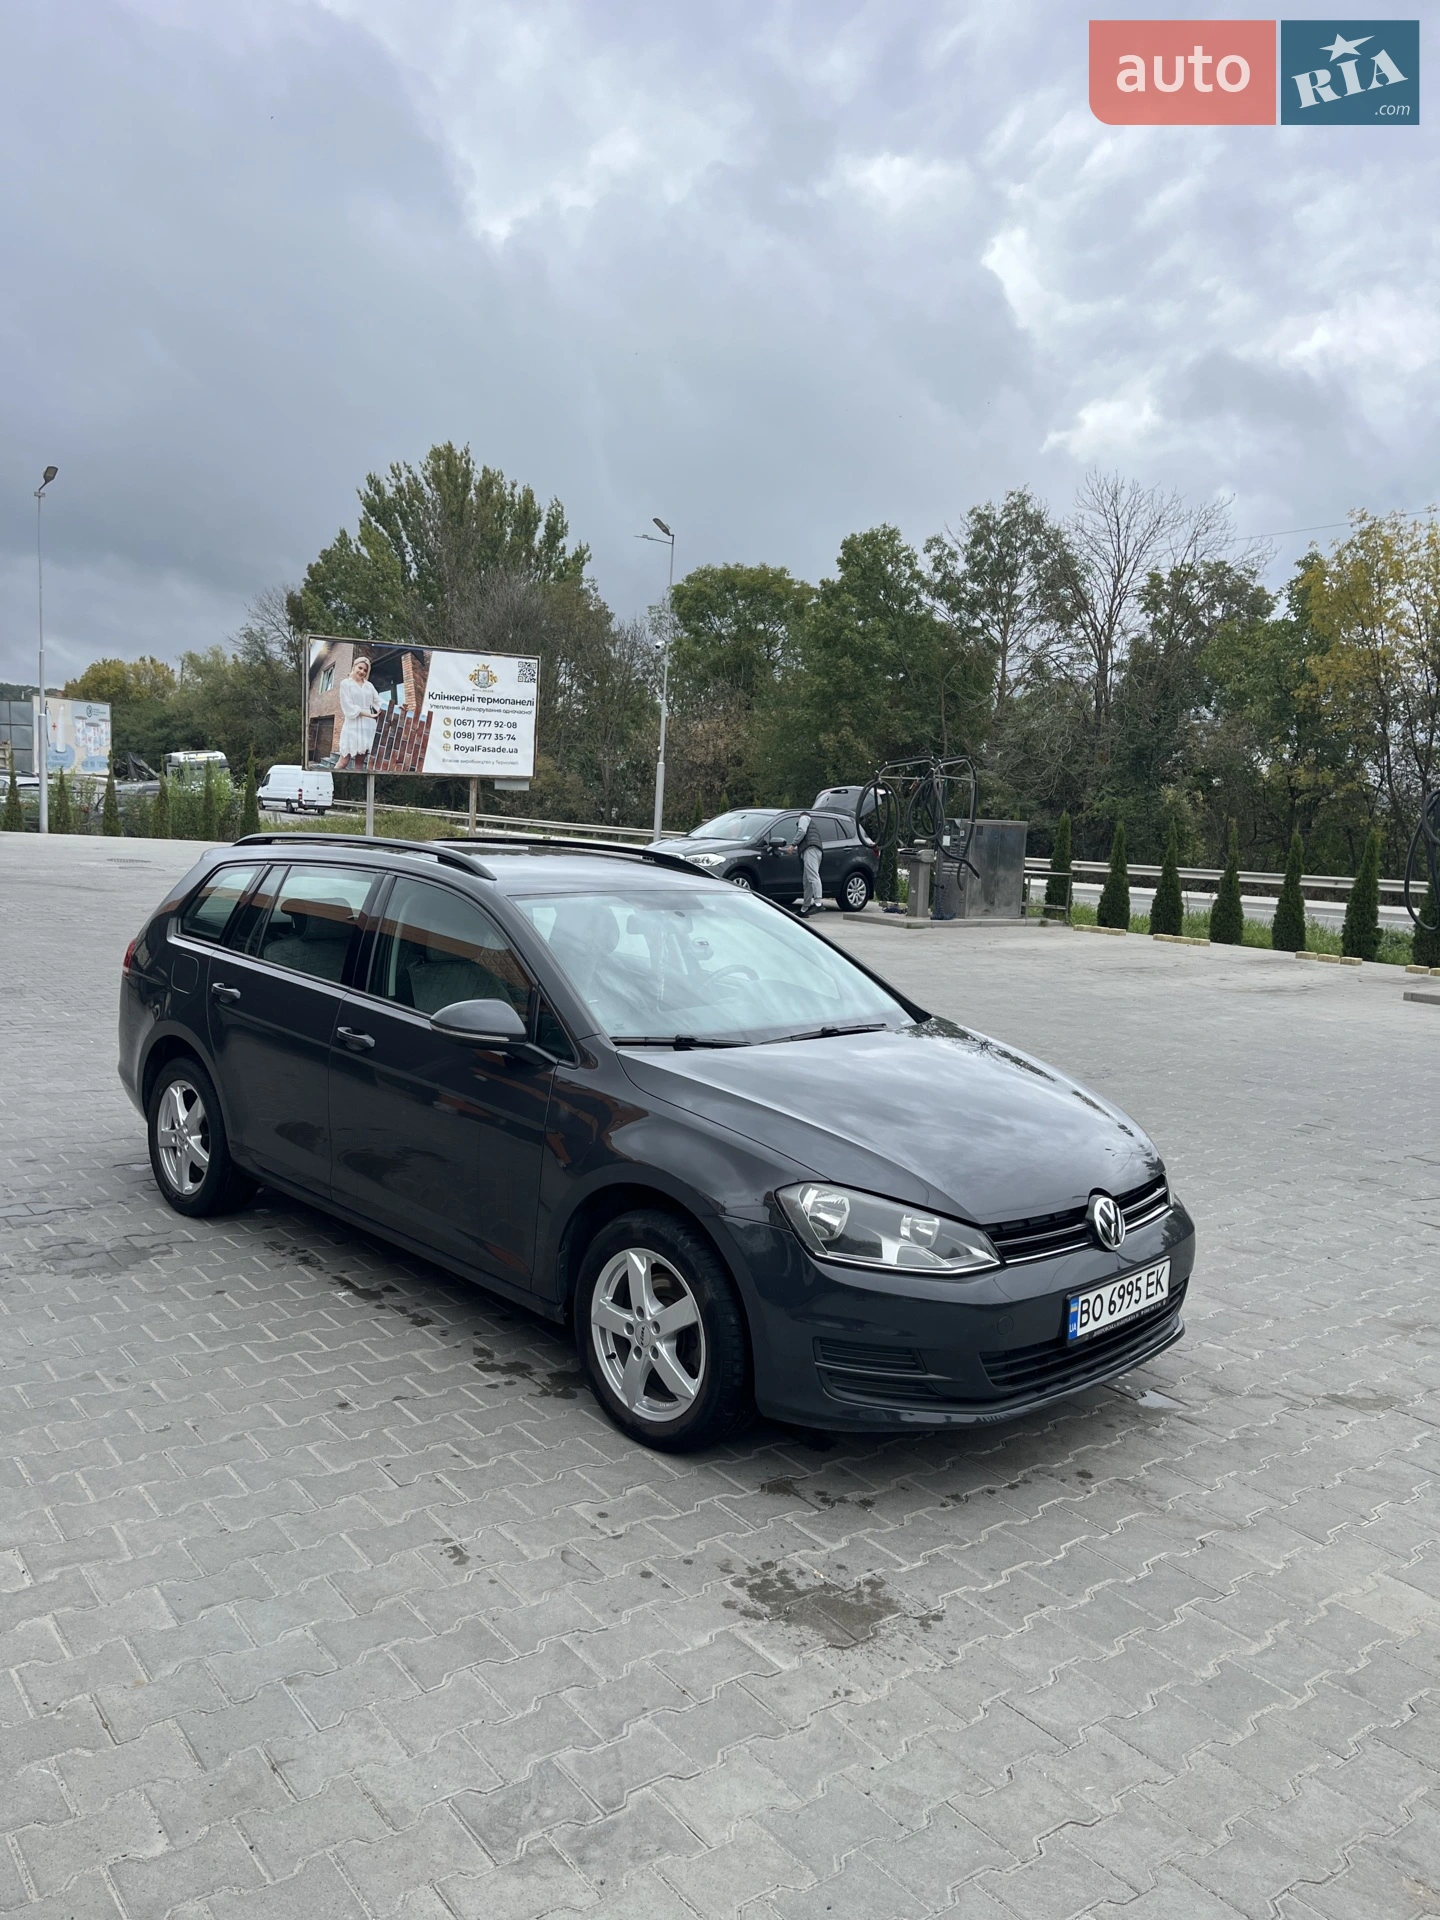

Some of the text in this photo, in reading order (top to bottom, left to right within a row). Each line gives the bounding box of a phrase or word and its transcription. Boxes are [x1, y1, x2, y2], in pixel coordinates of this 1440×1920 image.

[428, 692, 535, 707] Клінкерні термопанелі
[453, 718, 517, 729] (067) 777 92-08
[453, 731, 475, 741] (098)
[494, 733, 516, 741] 35-74
[454, 744, 518, 754] RoyalFasade.ua
[1079, 1293, 1104, 1328] BO
[1108, 1276, 1142, 1316] 6995
[1146, 1266, 1166, 1300] EK
[1069, 1321, 1077, 1333] UA
